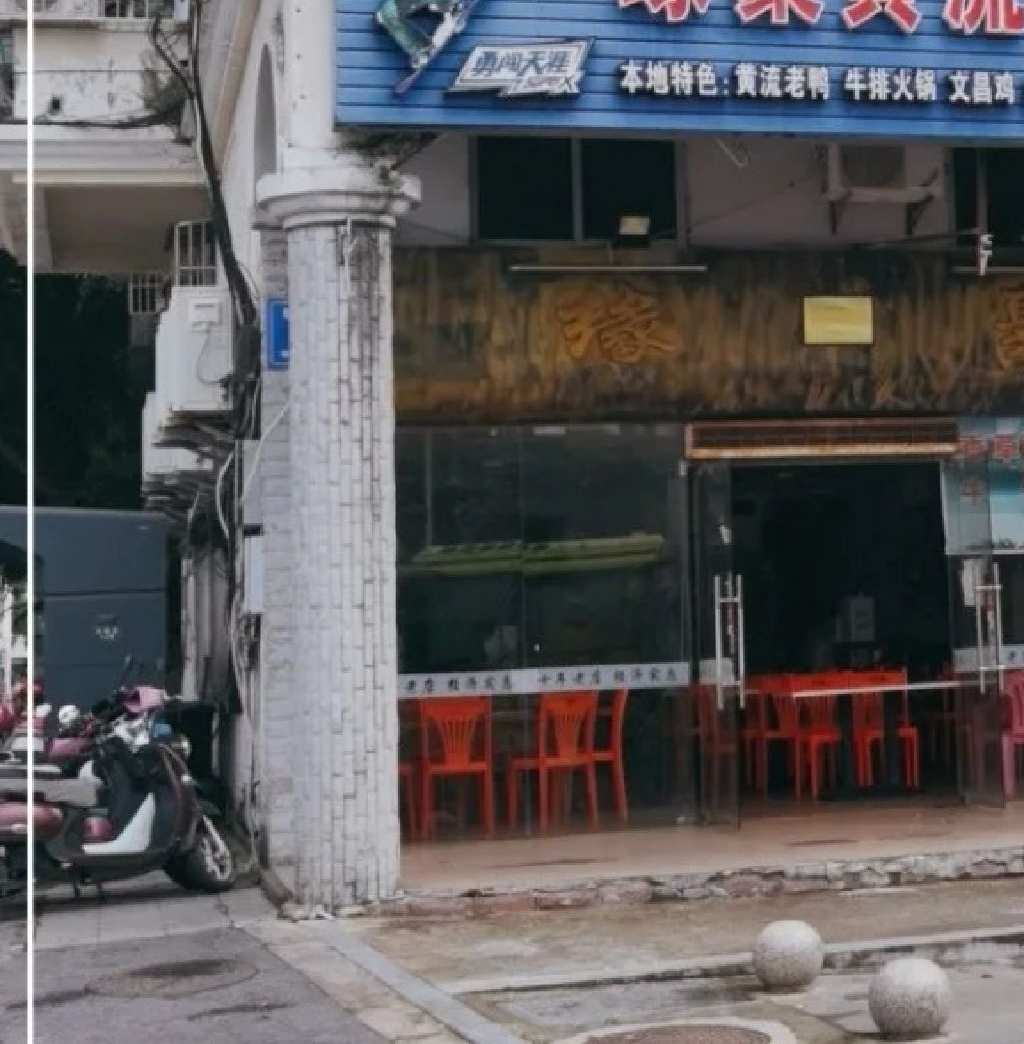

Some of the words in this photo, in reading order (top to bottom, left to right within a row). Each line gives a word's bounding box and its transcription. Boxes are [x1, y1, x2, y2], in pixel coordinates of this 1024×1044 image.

[472, 51, 570, 77] 勇闯天涯
[844, 67, 936, 101] 牛排火锅
[948, 70, 1015, 105] 文昌鸡
